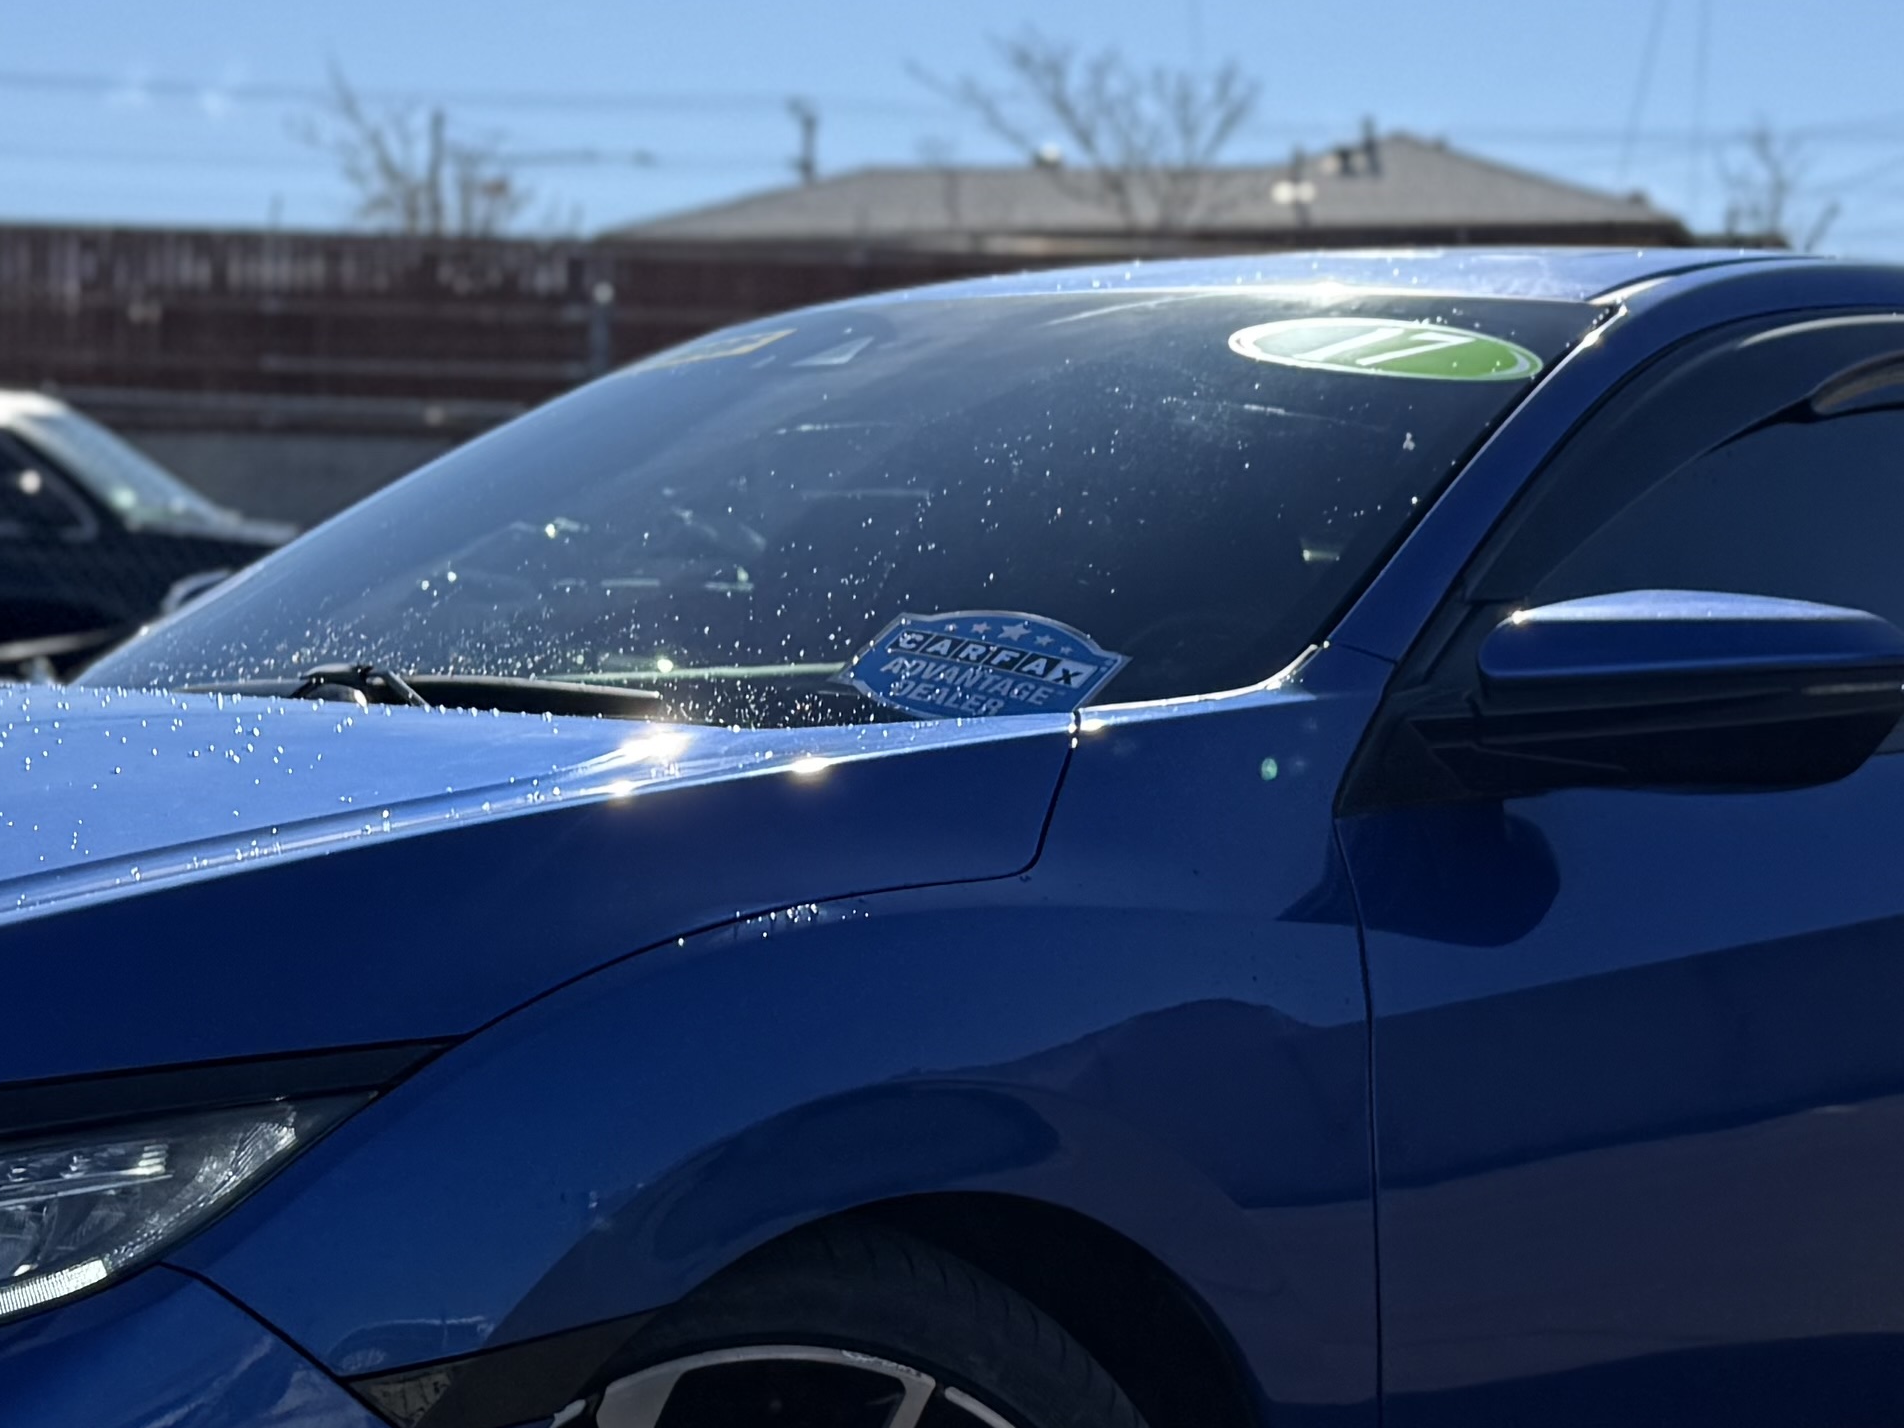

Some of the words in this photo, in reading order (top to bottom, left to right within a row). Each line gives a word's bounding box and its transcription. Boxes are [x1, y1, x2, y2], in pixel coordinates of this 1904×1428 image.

[880, 656, 1055, 706] ADVANTAGE
[895, 631, 1086, 687] CARFAX
[893, 680, 1005, 715] DEALER
